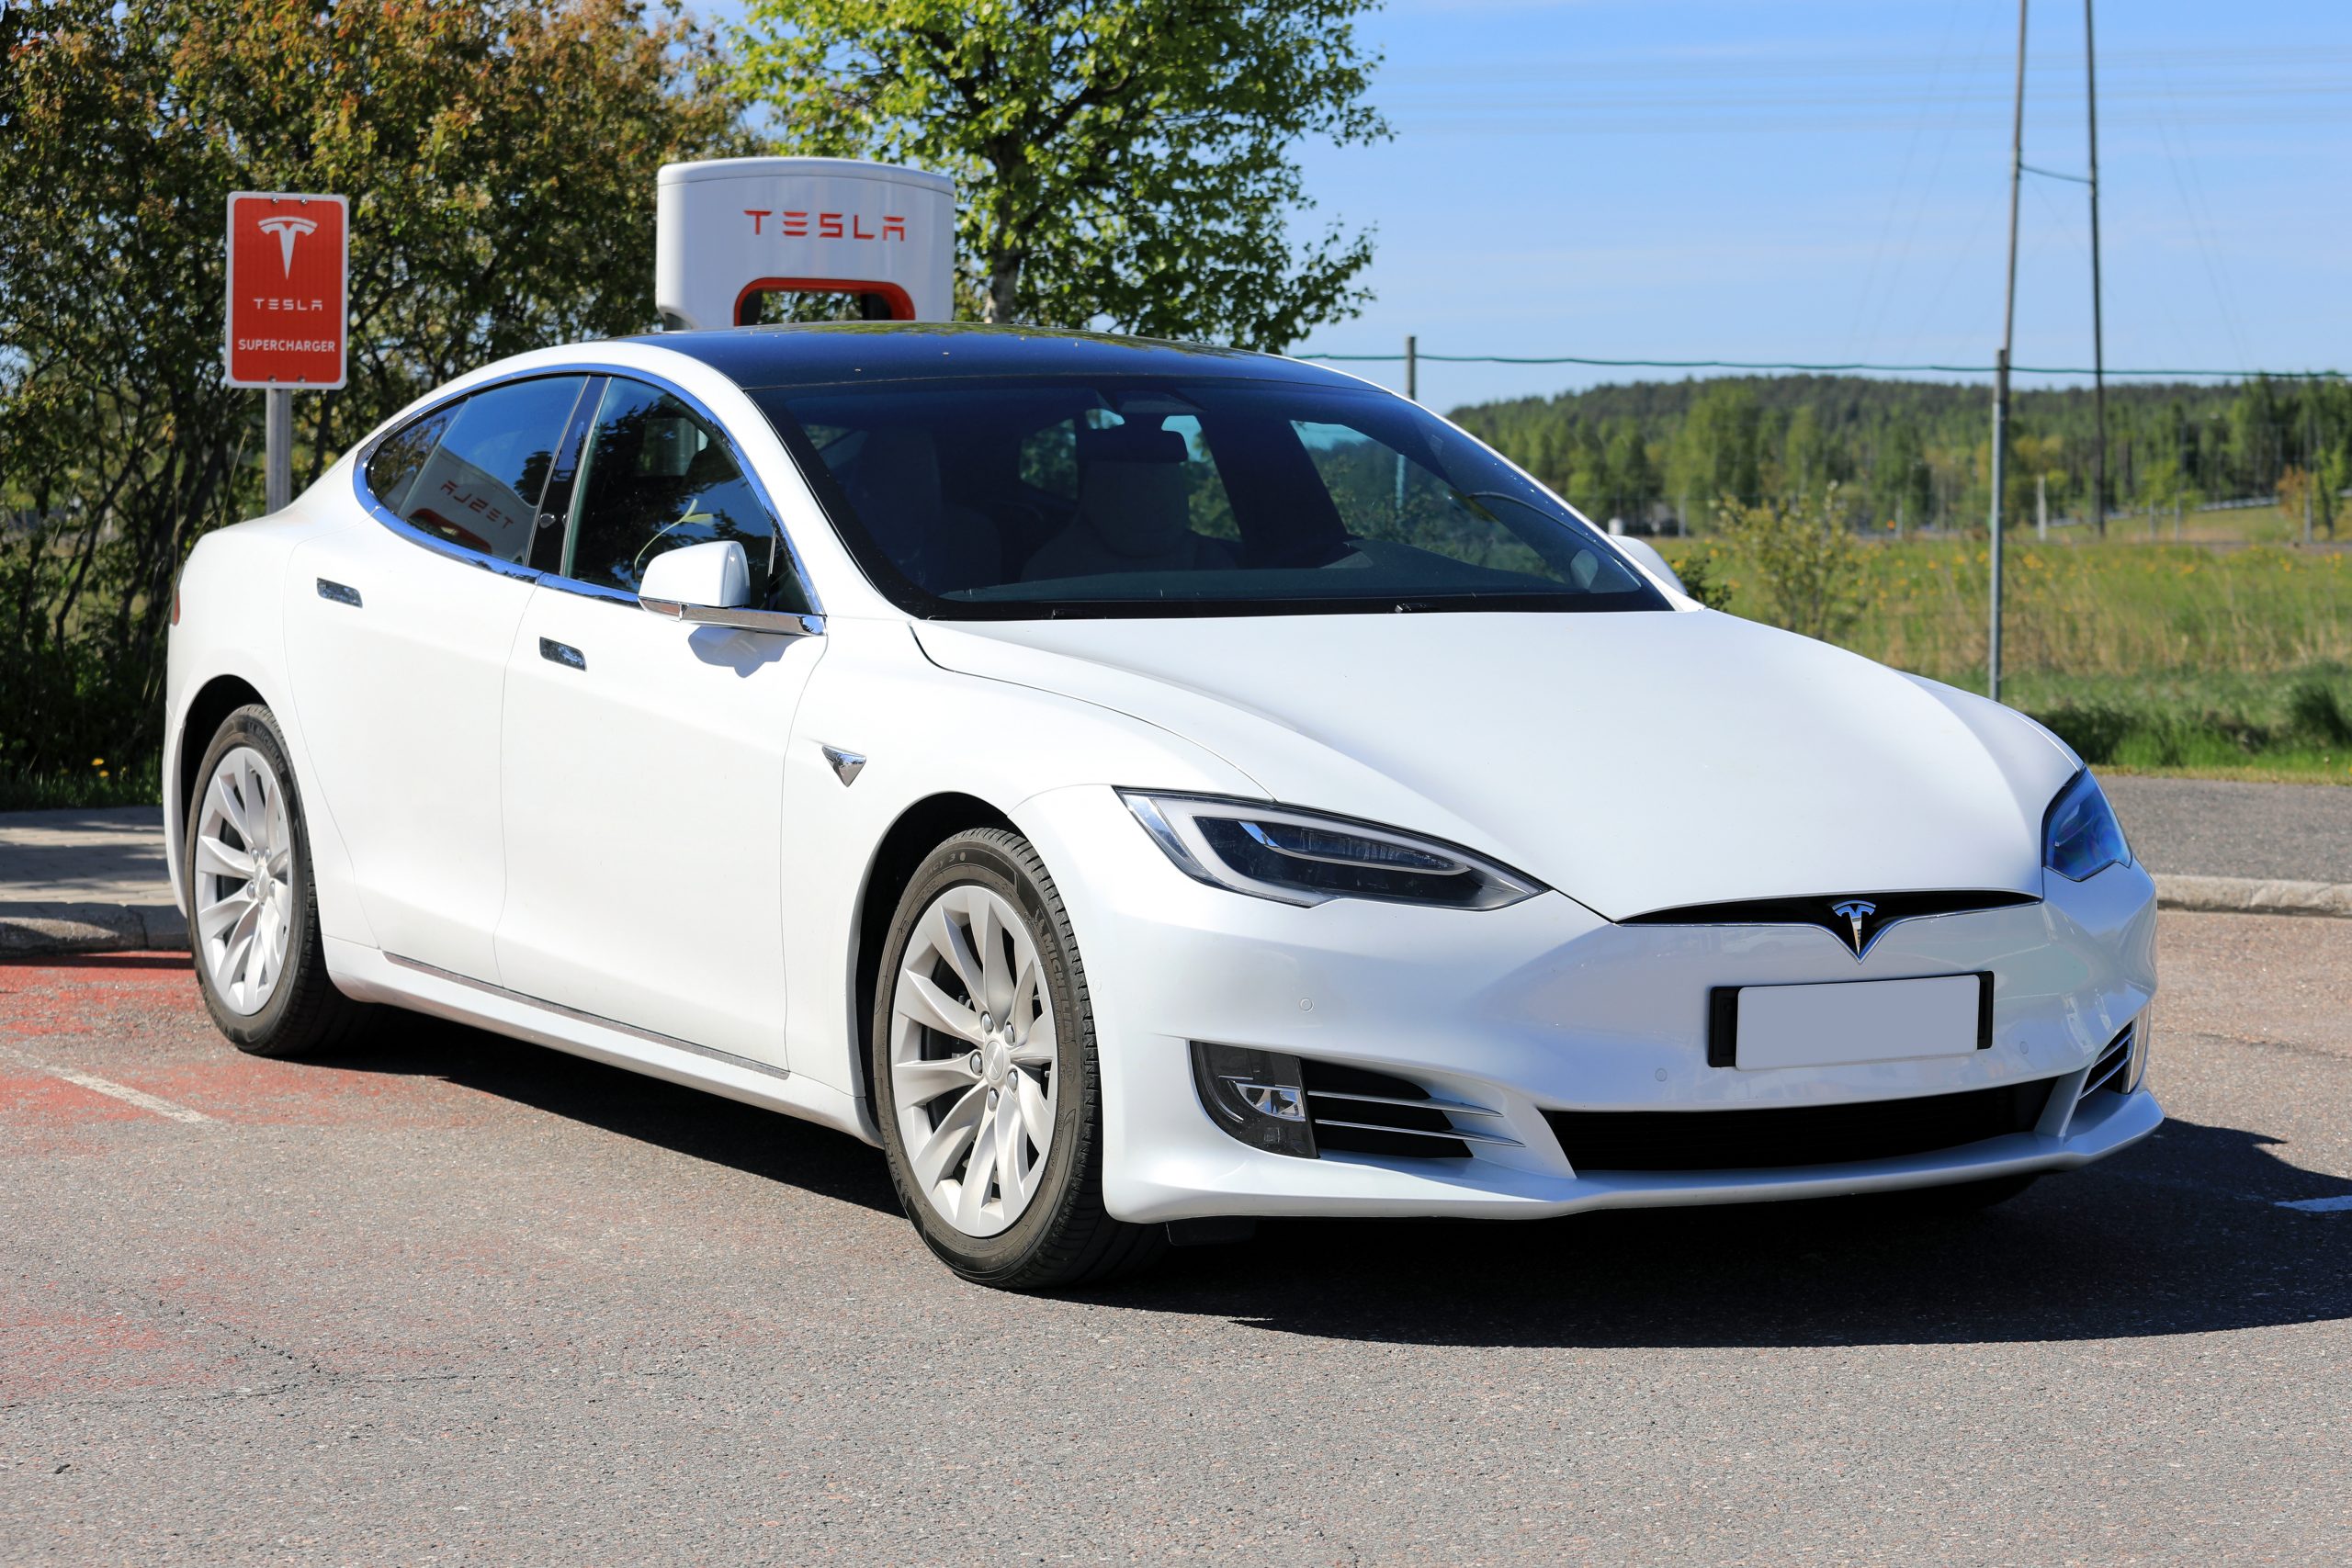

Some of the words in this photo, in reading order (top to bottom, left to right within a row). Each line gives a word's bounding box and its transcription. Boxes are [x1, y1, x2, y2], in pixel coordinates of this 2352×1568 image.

[743, 210, 905, 242] TESLA
[254, 299, 322, 310] TESLA
[238, 339, 335, 352] SUPERCHARGER
[1042, 933, 1076, 1042] MICHELIN
